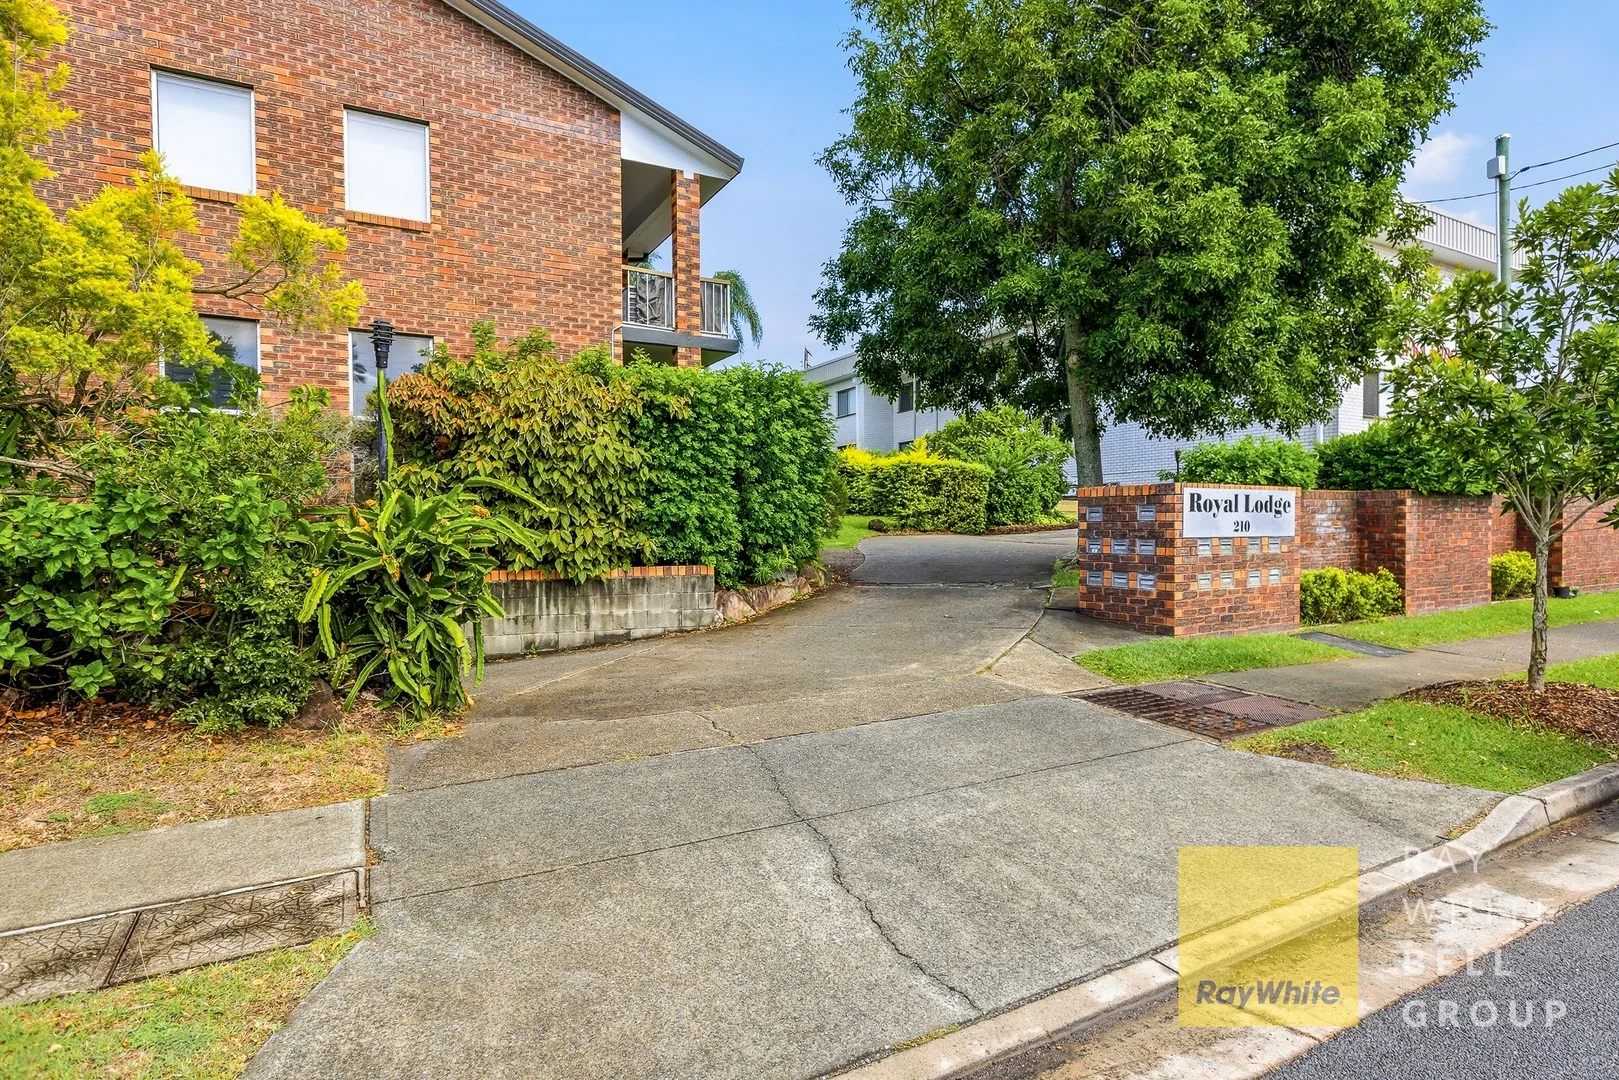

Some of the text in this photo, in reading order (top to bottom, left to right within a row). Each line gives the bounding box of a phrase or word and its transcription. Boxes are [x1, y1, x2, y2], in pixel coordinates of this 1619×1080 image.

[1189, 493, 1292, 518] Royal Lodge
[1233, 520, 1251, 533] 210
